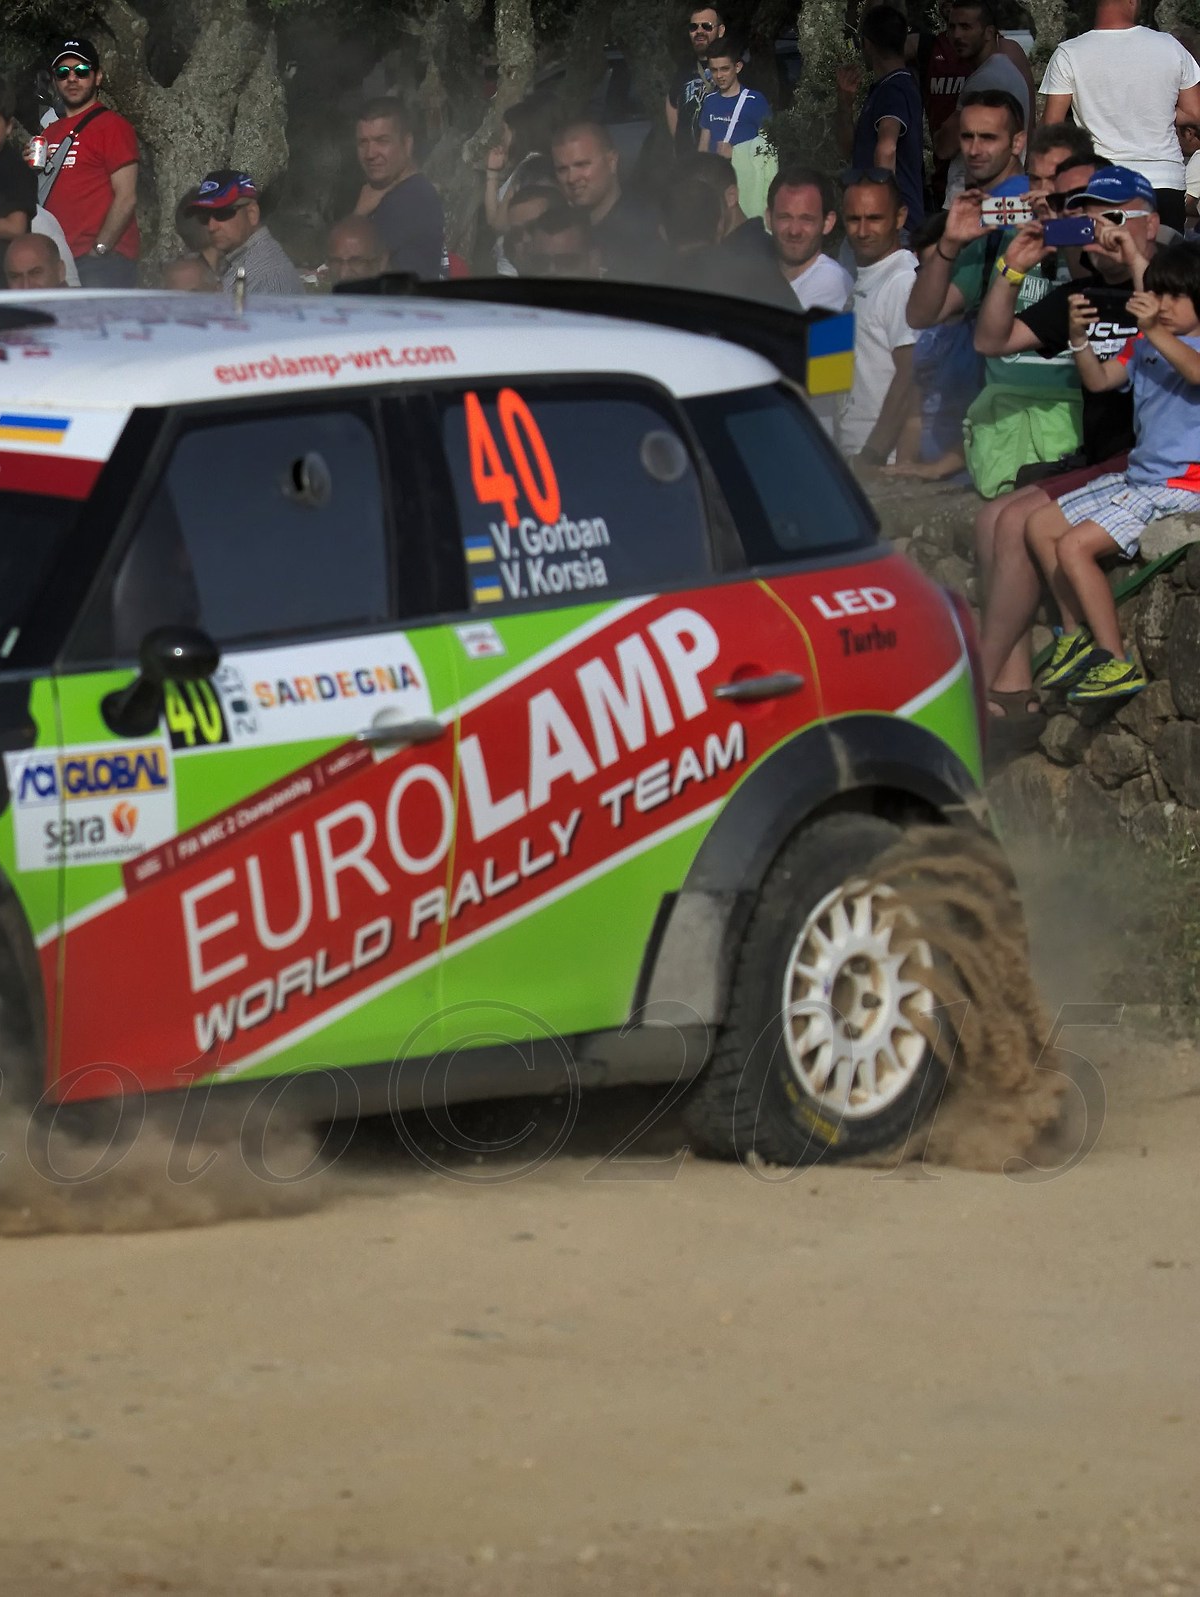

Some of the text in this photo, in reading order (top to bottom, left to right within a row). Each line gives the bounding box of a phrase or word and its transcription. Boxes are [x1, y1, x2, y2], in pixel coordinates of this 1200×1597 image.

[213, 345, 457, 384] eurolamp-wrt.com
[464, 387, 562, 528] 40
[810, 586, 897, 620] LED
[254, 663, 421, 708] SARDEGNA
[163, 679, 223, 746] 40
[63, 753, 168, 794] GLOBAL
[180, 607, 720, 993] EUROLAMP
[225, 818, 236, 834] 2
[235, 776, 313, 828] Championship
[44, 815, 105, 849] sara
[195, 721, 746, 1053] WORLD RALLY TEAM
